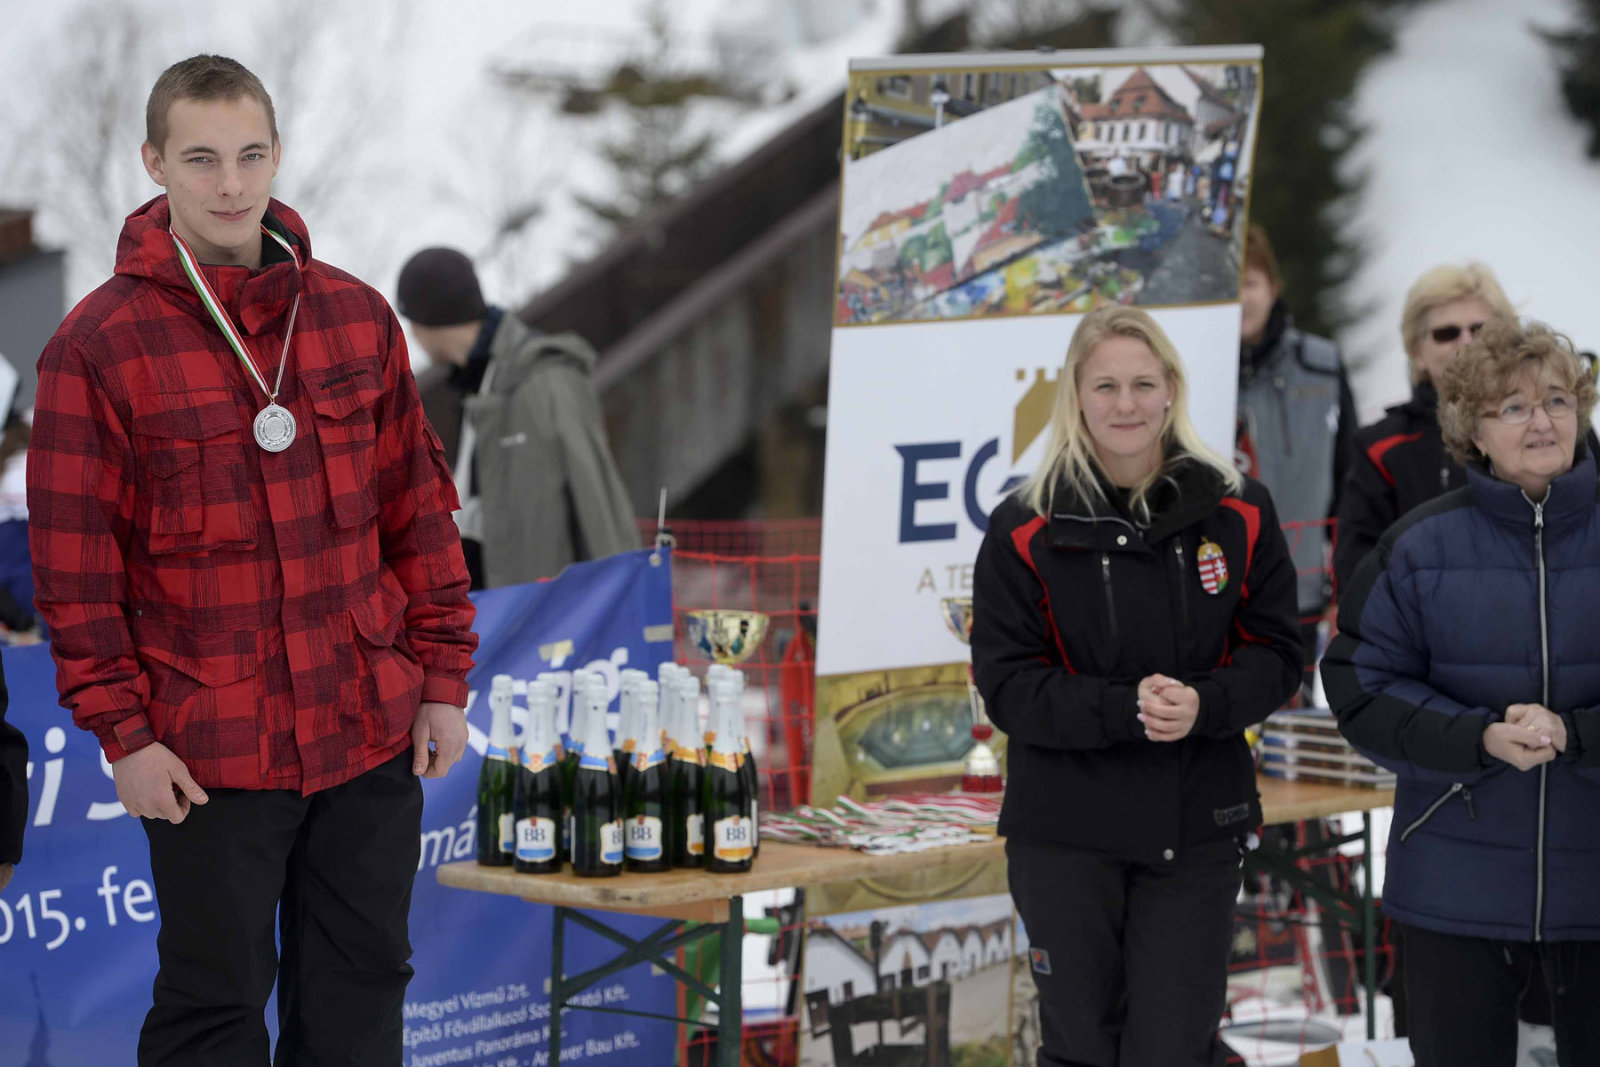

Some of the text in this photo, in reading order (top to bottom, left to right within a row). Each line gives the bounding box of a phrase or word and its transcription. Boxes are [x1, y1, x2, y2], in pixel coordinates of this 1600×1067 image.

[917, 567, 937, 593] A
[524, 828, 546, 842] BB
[631, 826, 652, 841] BB
[726, 826, 746, 842] BB
[97, 865, 155, 928] fe
[604, 983, 630, 1004] Kft.
[402, 994, 459, 1020] Megyei
[585, 1038, 614, 1057] Bau
[614, 1030, 640, 1051] Kft.
